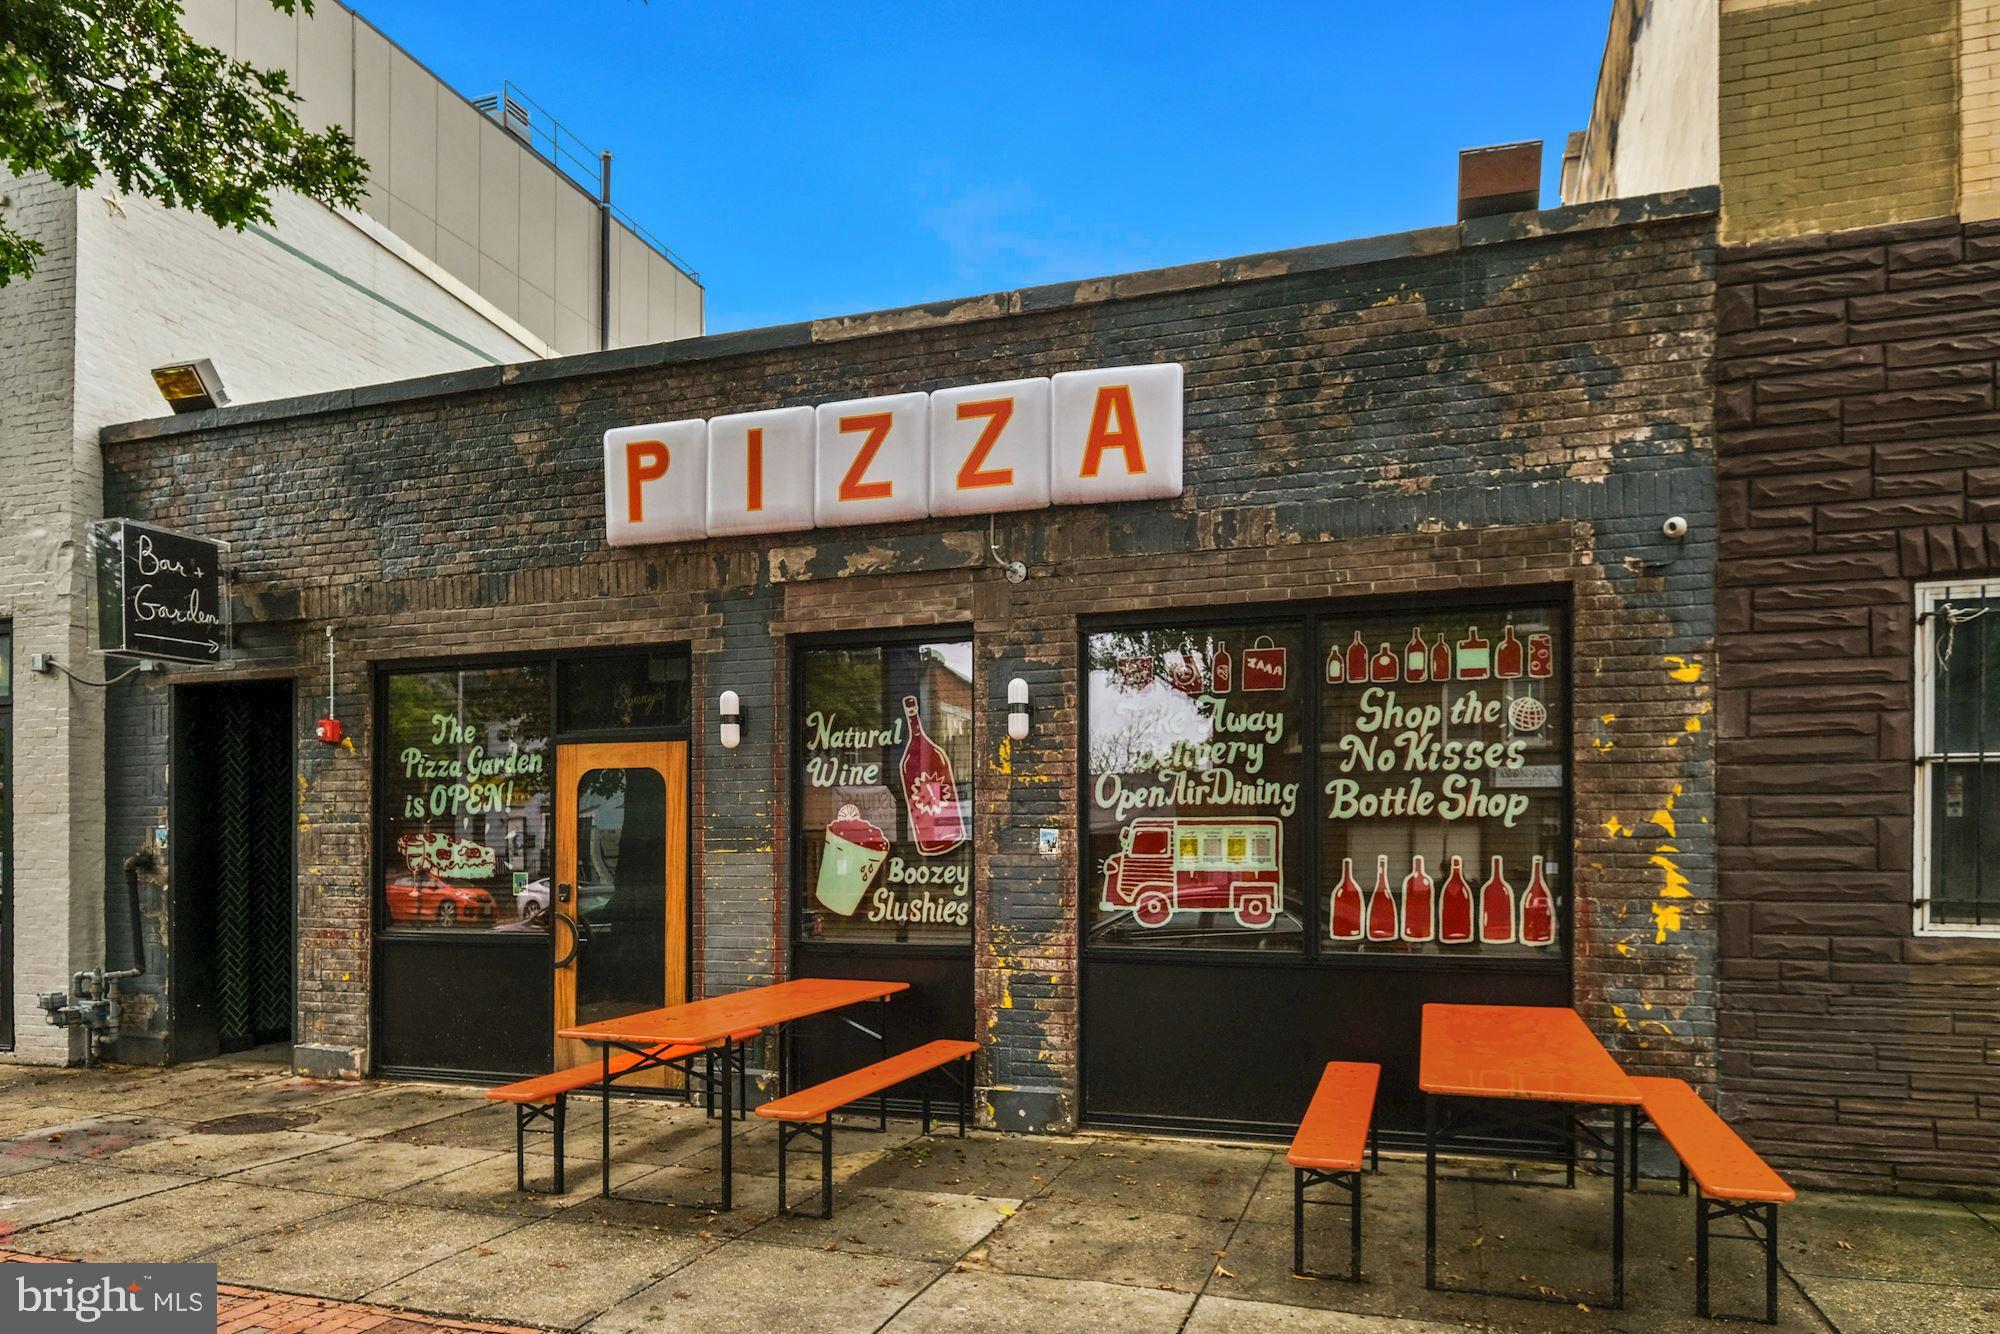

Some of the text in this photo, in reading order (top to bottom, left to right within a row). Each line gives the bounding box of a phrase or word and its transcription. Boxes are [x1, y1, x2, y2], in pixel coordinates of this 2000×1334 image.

[626, 384, 1148, 523] PIZZA
[138, 534, 187, 577] Bar
[134, 583, 219, 625] Garden
[431, 713, 476, 745] The
[806, 711, 902, 750] Natural
[1198, 694, 1284, 744] Away
[1355, 686, 1501, 737] Shop the
[400, 742, 543, 783] Pizza Garden
[806, 756, 879, 788] Wine
[1339, 730, 1528, 773] No Kisses
[404, 780, 514, 818] is OPEN!
[1094, 767, 1300, 822] Open Air Dining
[1324, 776, 1436, 820] Bottle
[1437, 773, 1530, 828] Shop
[888, 856, 969, 896] Boozey
[868, 887, 969, 926] Slushies
